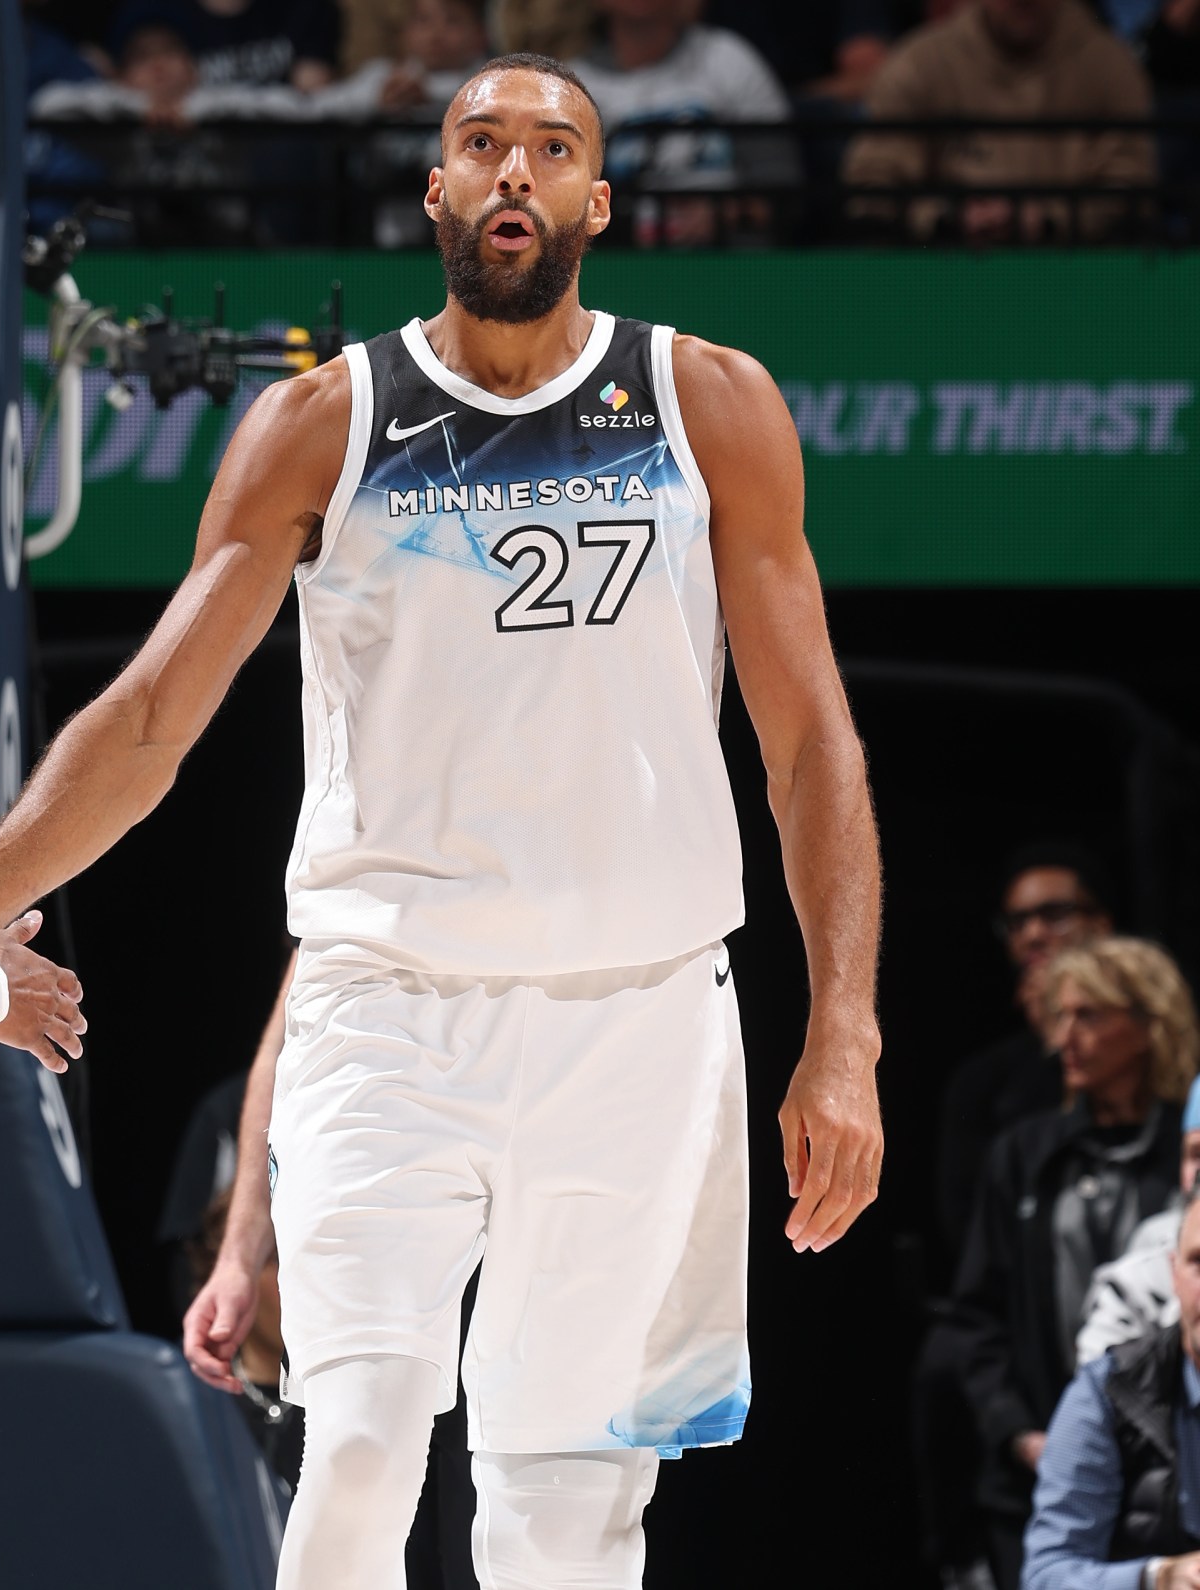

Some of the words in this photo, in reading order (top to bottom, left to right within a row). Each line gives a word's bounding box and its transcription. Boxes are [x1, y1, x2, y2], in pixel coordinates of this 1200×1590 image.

[580, 411, 656, 428] sezzle
[389, 474, 653, 517] MINNESOTA
[490, 519, 656, 633] 27
